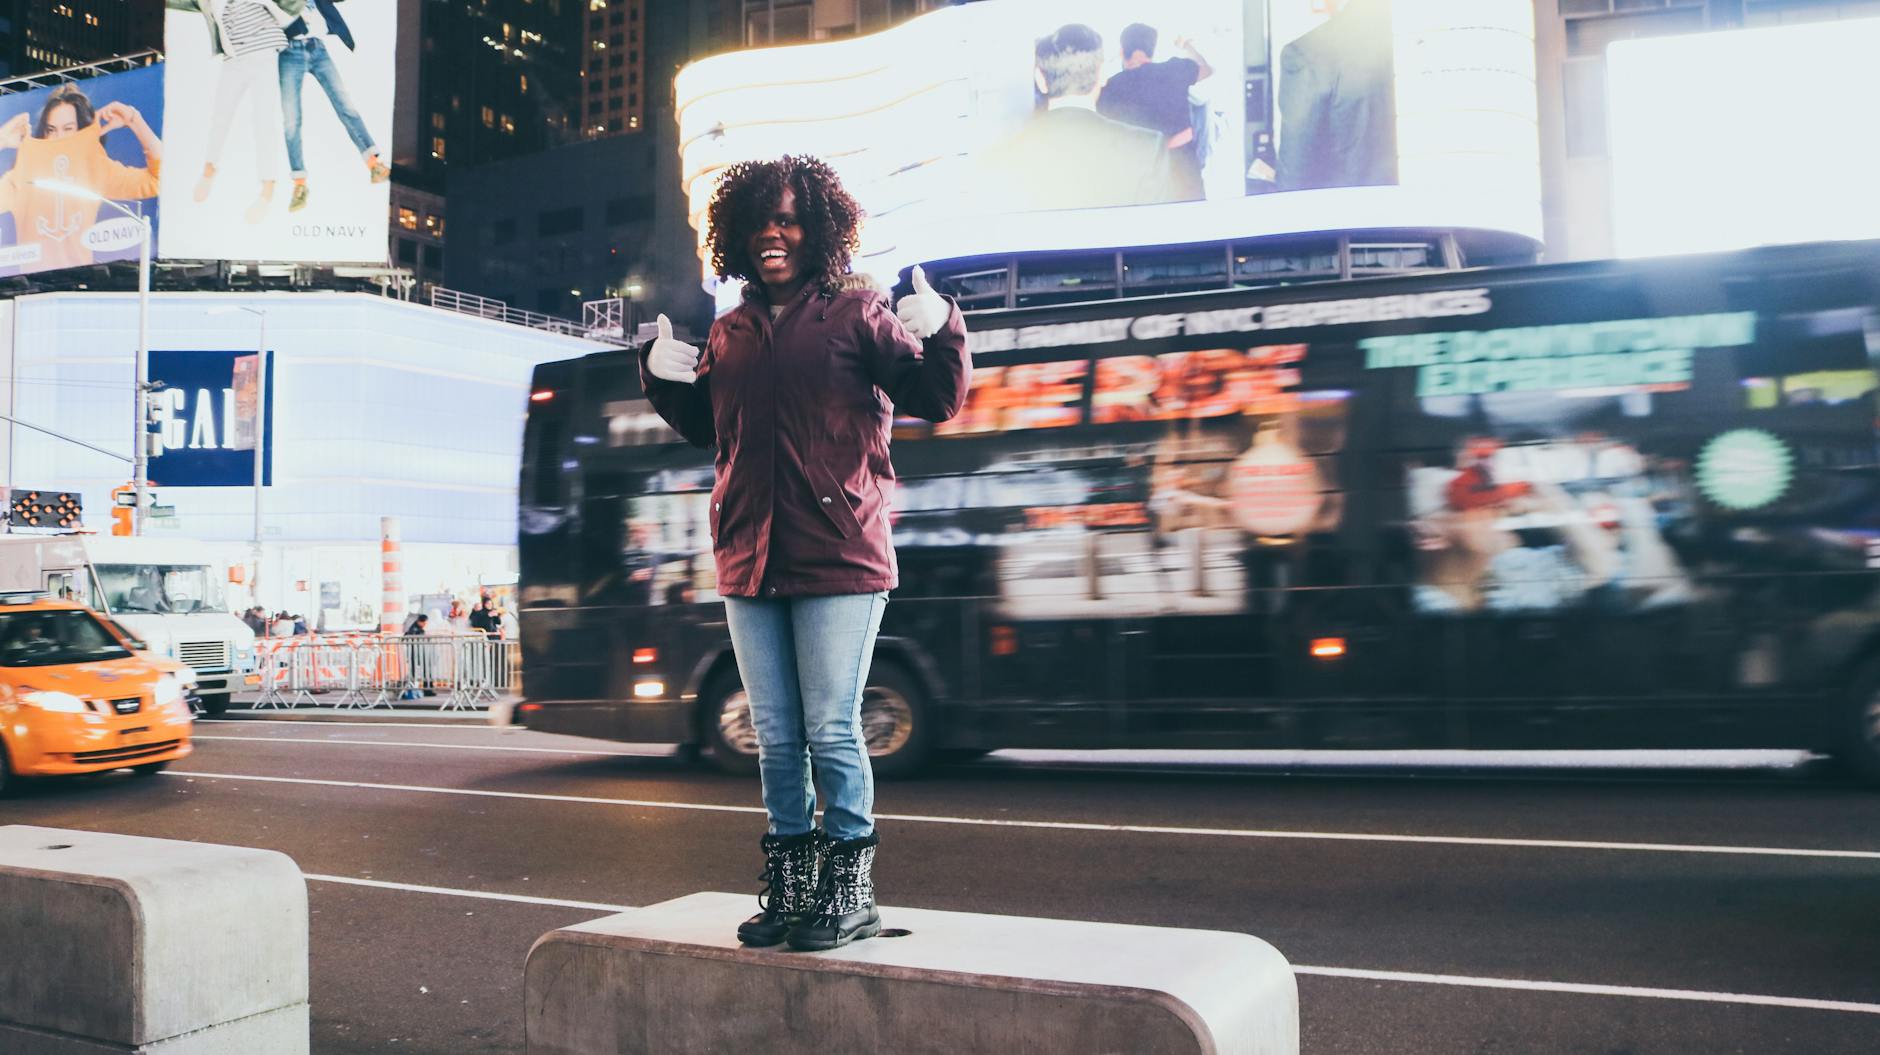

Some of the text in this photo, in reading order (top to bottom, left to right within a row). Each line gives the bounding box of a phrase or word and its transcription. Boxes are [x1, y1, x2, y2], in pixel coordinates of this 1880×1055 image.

[89, 225, 141, 244] OLD NAVY
[292, 224, 367, 237] OLD NAVY
[967, 288, 1492, 353] UR FAMILY OF NYC EXPERIENCES
[1358, 311, 1757, 369] THE DOWNTOWN
[933, 343, 1309, 436] HE RIDE
[1416, 348, 1694, 397] EXPERIENCE
